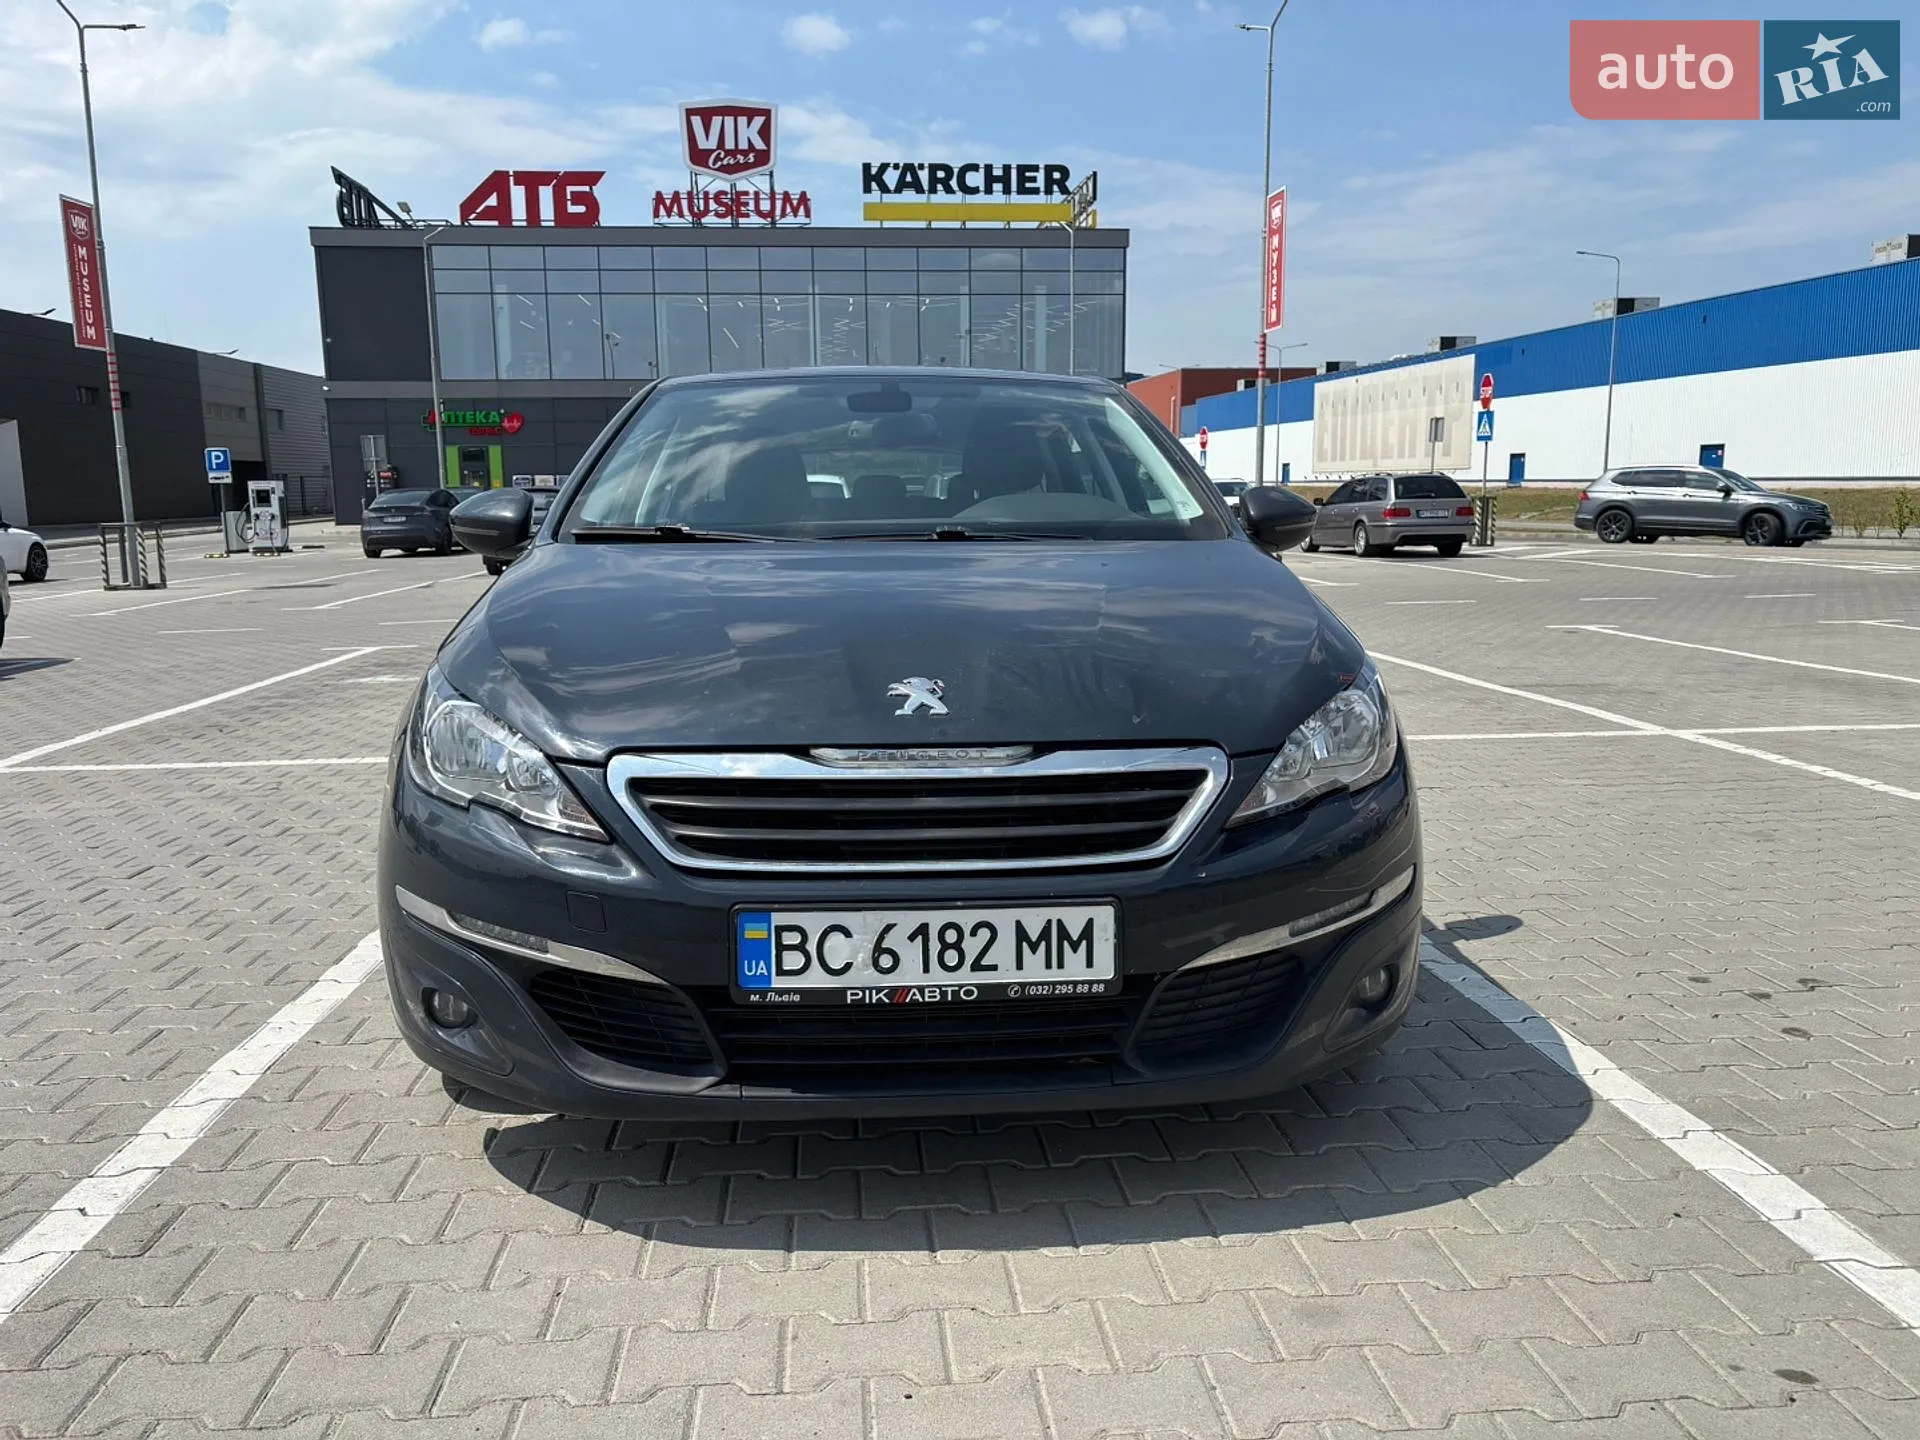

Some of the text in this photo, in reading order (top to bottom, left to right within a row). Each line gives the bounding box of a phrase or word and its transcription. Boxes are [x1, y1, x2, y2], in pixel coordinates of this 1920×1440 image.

[690, 115, 768, 150] VIK
[708, 149, 755, 169] Cars
[862, 163, 1071, 195] KÄRCHER
[653, 190, 812, 220] MUSEUM
[78, 245, 96, 340] MUSEUM
[210, 451, 224, 469] P
[858, 750, 987, 760] PEUGEOT
[775, 917, 1095, 977] BC 6182 MM
[744, 961, 768, 976] UA
[1025, 983, 1105, 995] (032) 295 88 88
